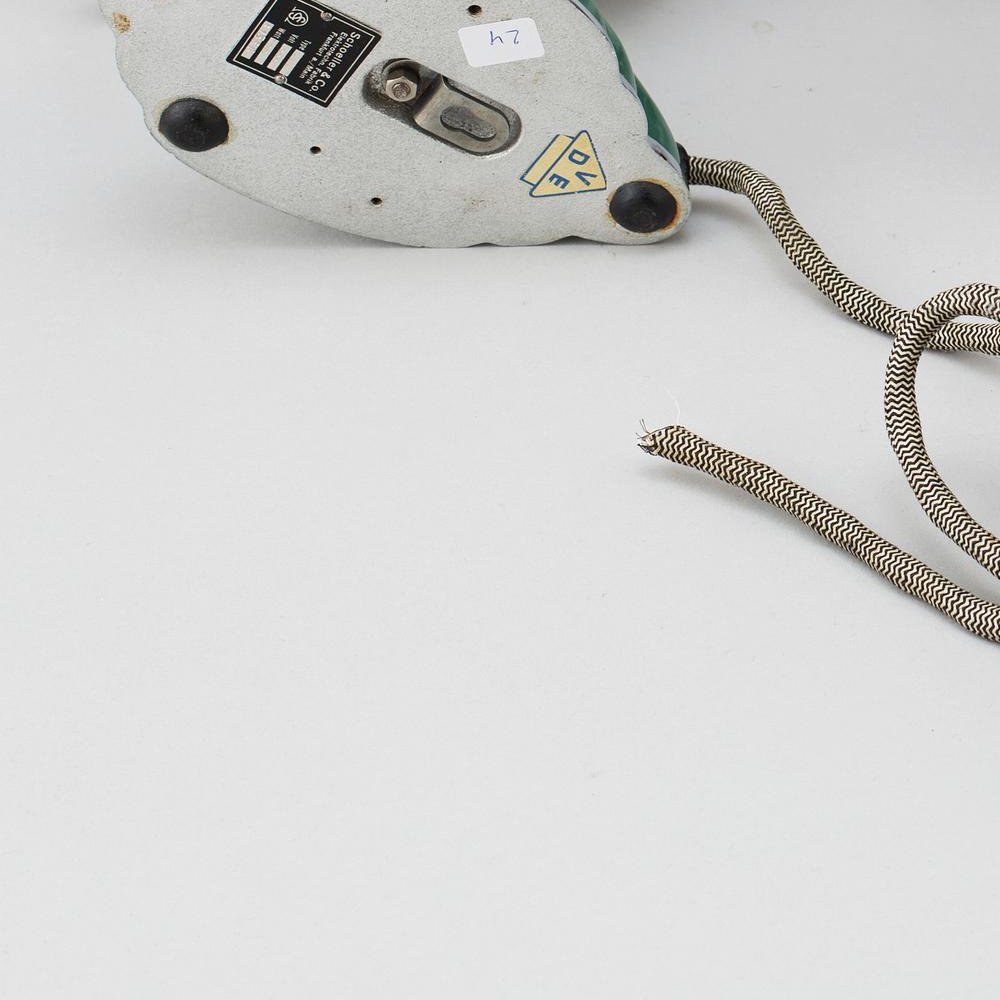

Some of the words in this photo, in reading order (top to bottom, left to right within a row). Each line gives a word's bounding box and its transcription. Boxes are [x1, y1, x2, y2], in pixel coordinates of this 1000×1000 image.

[298, 39, 311, 51] Type
[315, 31, 337, 56] Frankfurt
[489, 29, 519, 46] 24
[326, 31, 361, 72] Schoeller
[304, 67, 321, 84] Fabrik
[319, 71, 331, 80] &
[308, 77, 325, 93] Co.
